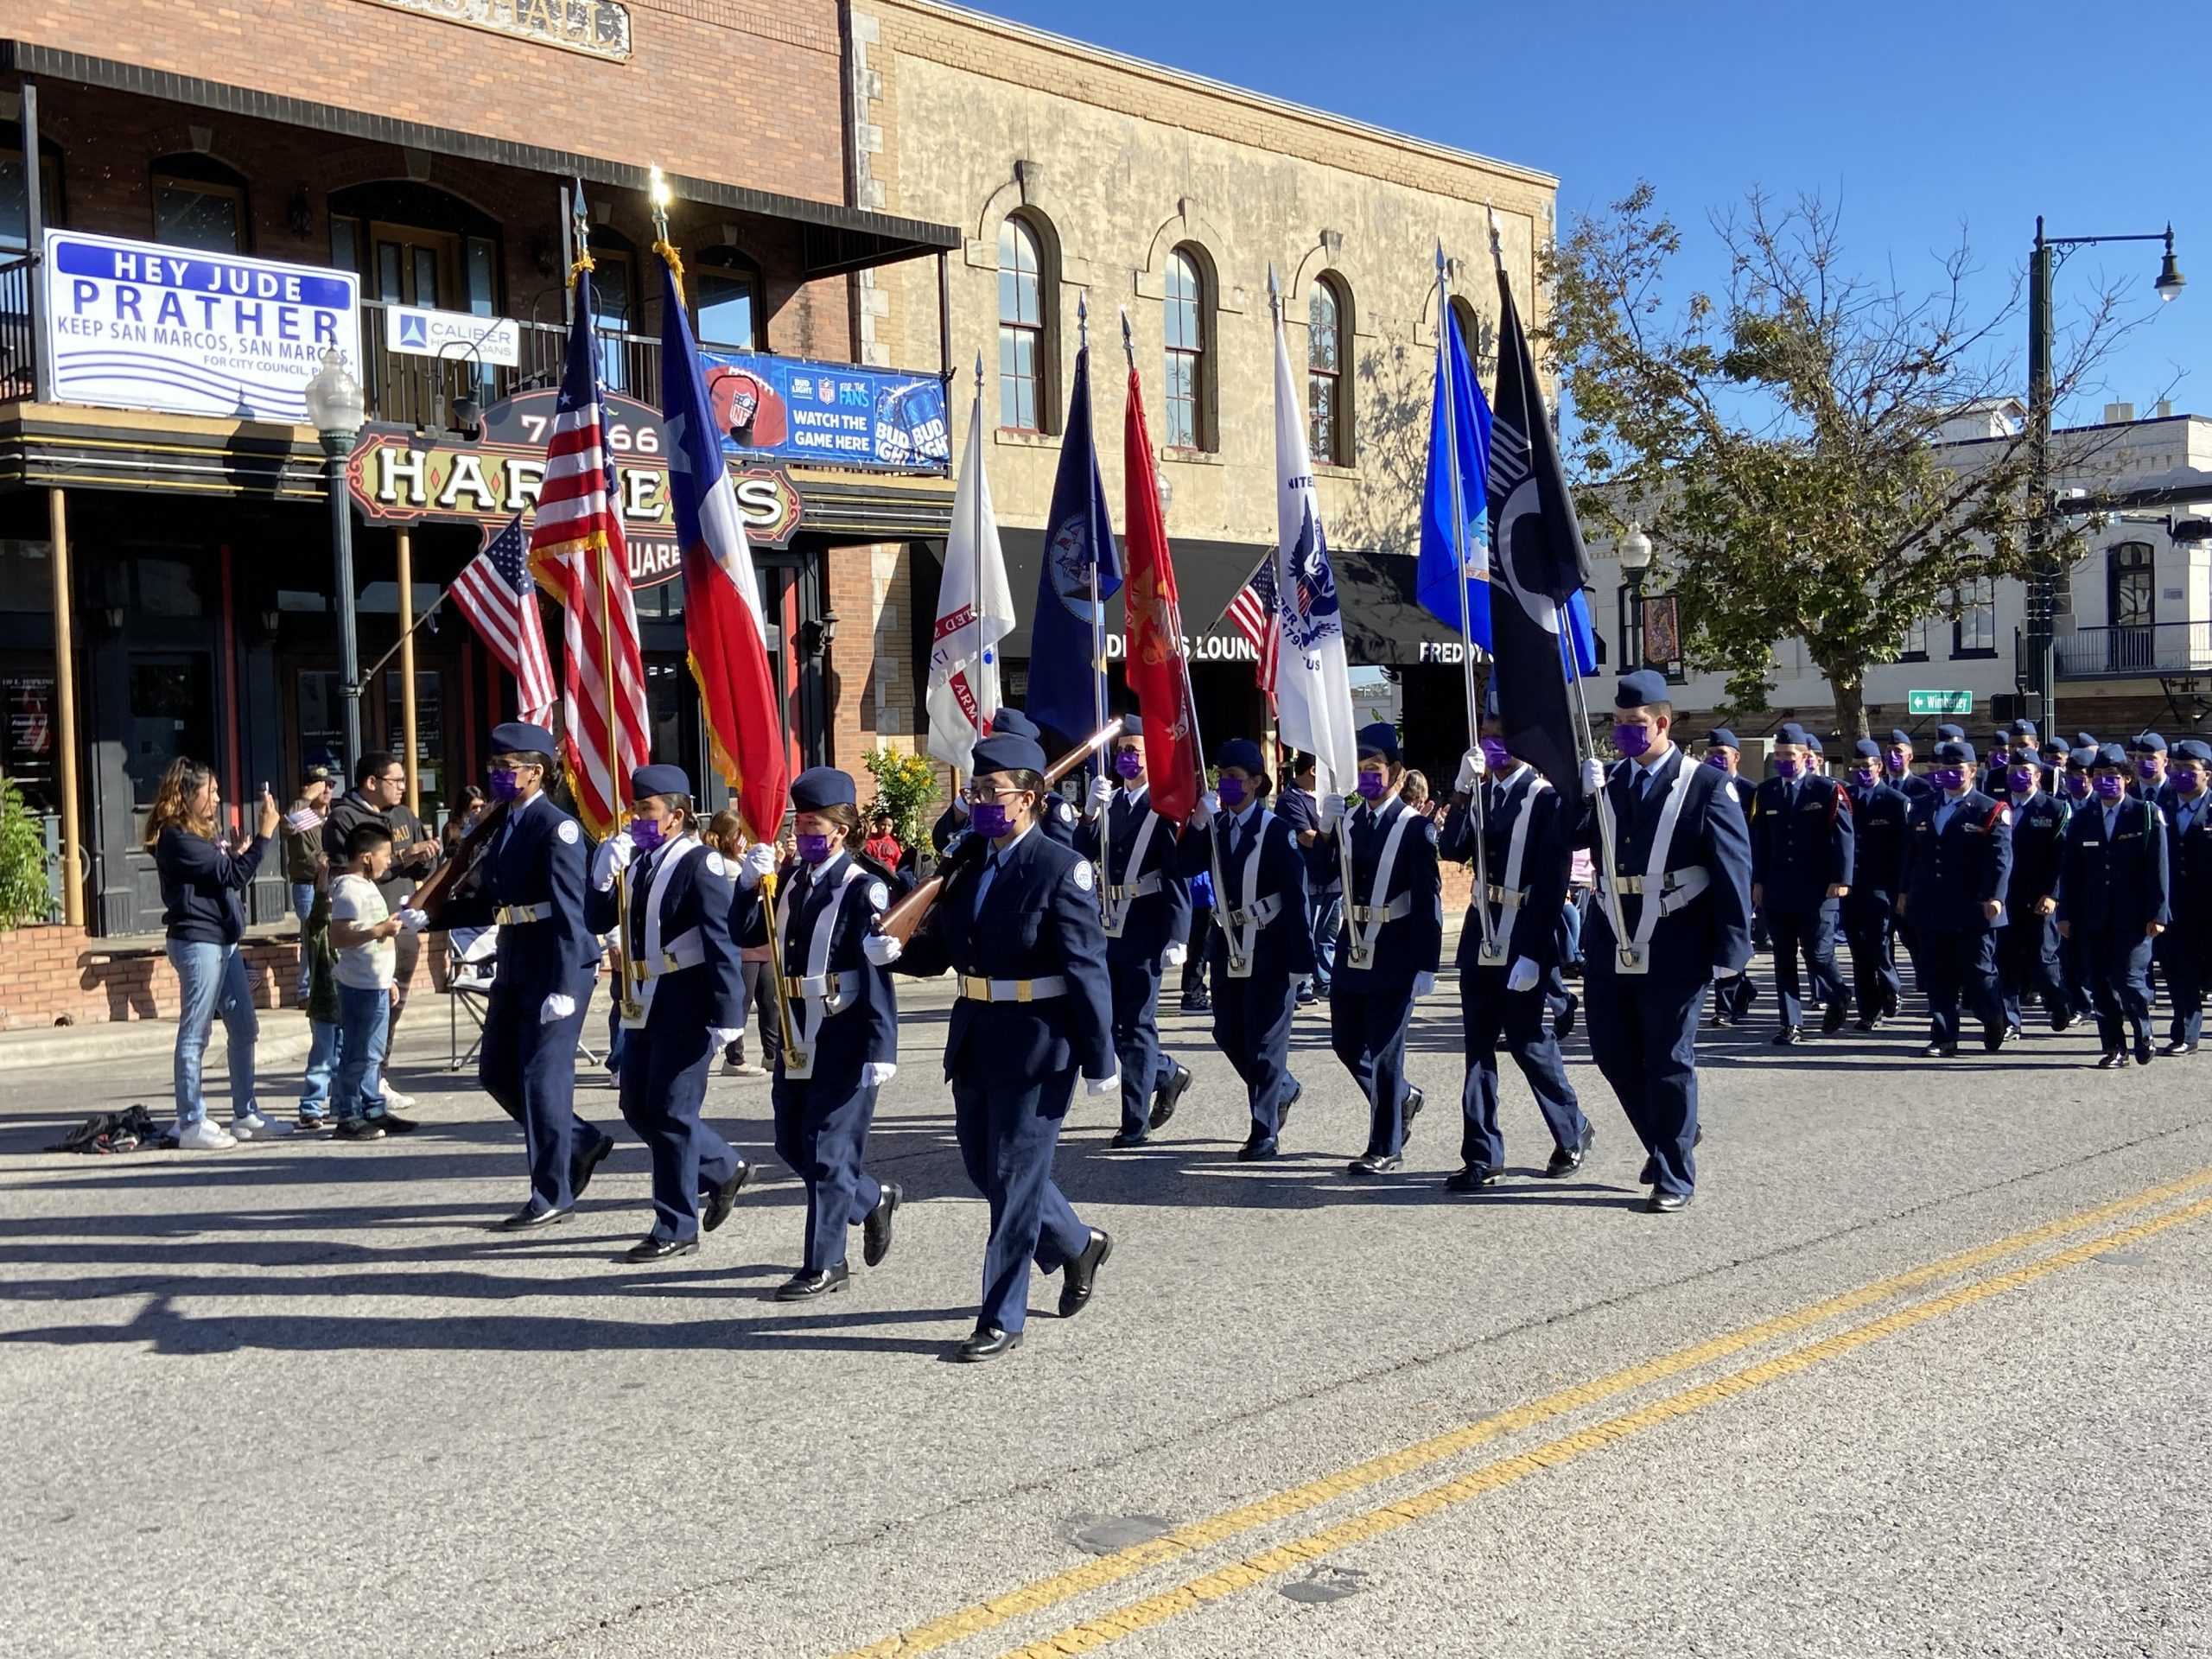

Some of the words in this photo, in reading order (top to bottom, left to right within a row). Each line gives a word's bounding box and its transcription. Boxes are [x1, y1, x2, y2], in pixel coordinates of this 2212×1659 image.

[115, 251, 189, 286] HEY
[208, 266, 302, 302] JUDE
[73, 278, 339, 344] PRATHER
[58, 315, 103, 337] KEEP
[111, 321, 146, 342] SAN
[154, 327, 233, 353] MARCOS,
[239, 338, 273, 357] SAN
[279, 342, 353, 365] MARCS.
[431, 322, 511, 345] CALIBER
[204, 355, 226, 368] FOR
[229, 357, 254, 371] CITY
[257, 360, 308, 377] COUNCIL,
[791, 385, 812, 395] LIGHT
[794, 378, 810, 387] BUD
[839, 389, 869, 407] FANS
[793, 410, 839, 429] WATCH
[842, 415, 868, 431] THE
[795, 430, 834, 448] GAME
[836, 435, 871, 451] HERE
[876, 421, 910, 448] BUD
[912, 418, 944, 447] BUD
[1927, 695, 1967, 713] Wimberley
